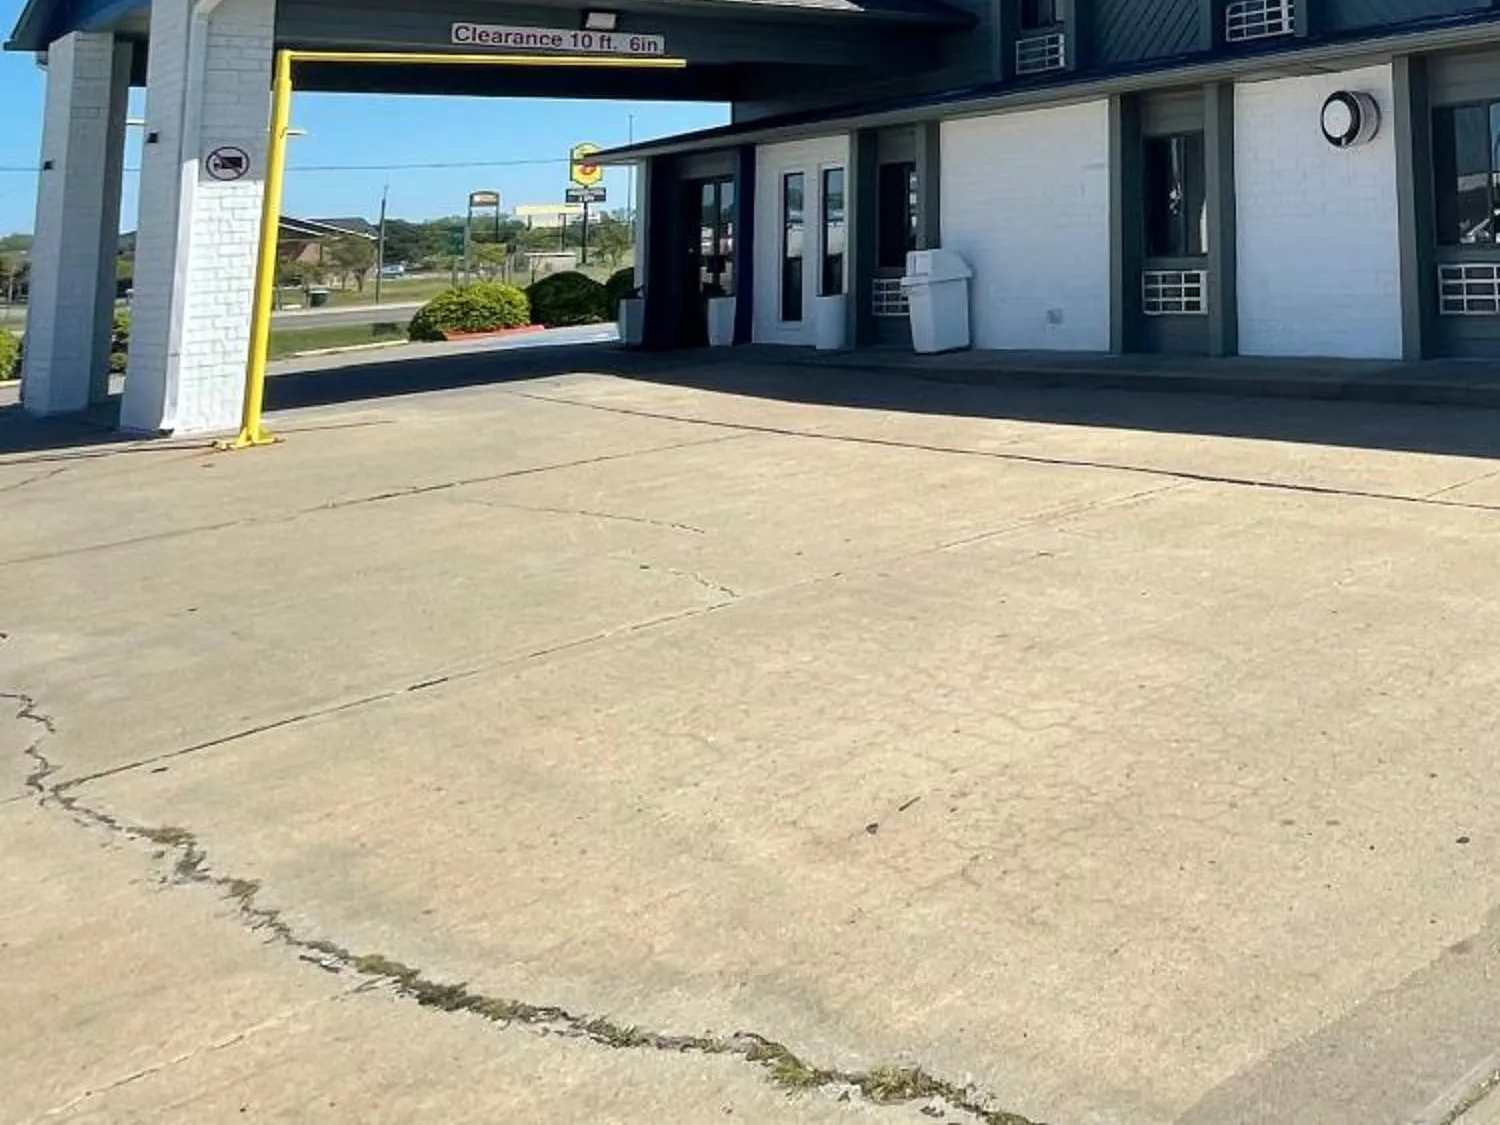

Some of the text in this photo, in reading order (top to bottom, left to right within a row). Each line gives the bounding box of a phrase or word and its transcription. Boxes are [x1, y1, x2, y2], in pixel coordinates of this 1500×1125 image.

[454, 25, 658, 52] Clearance 10 ft. 6in
